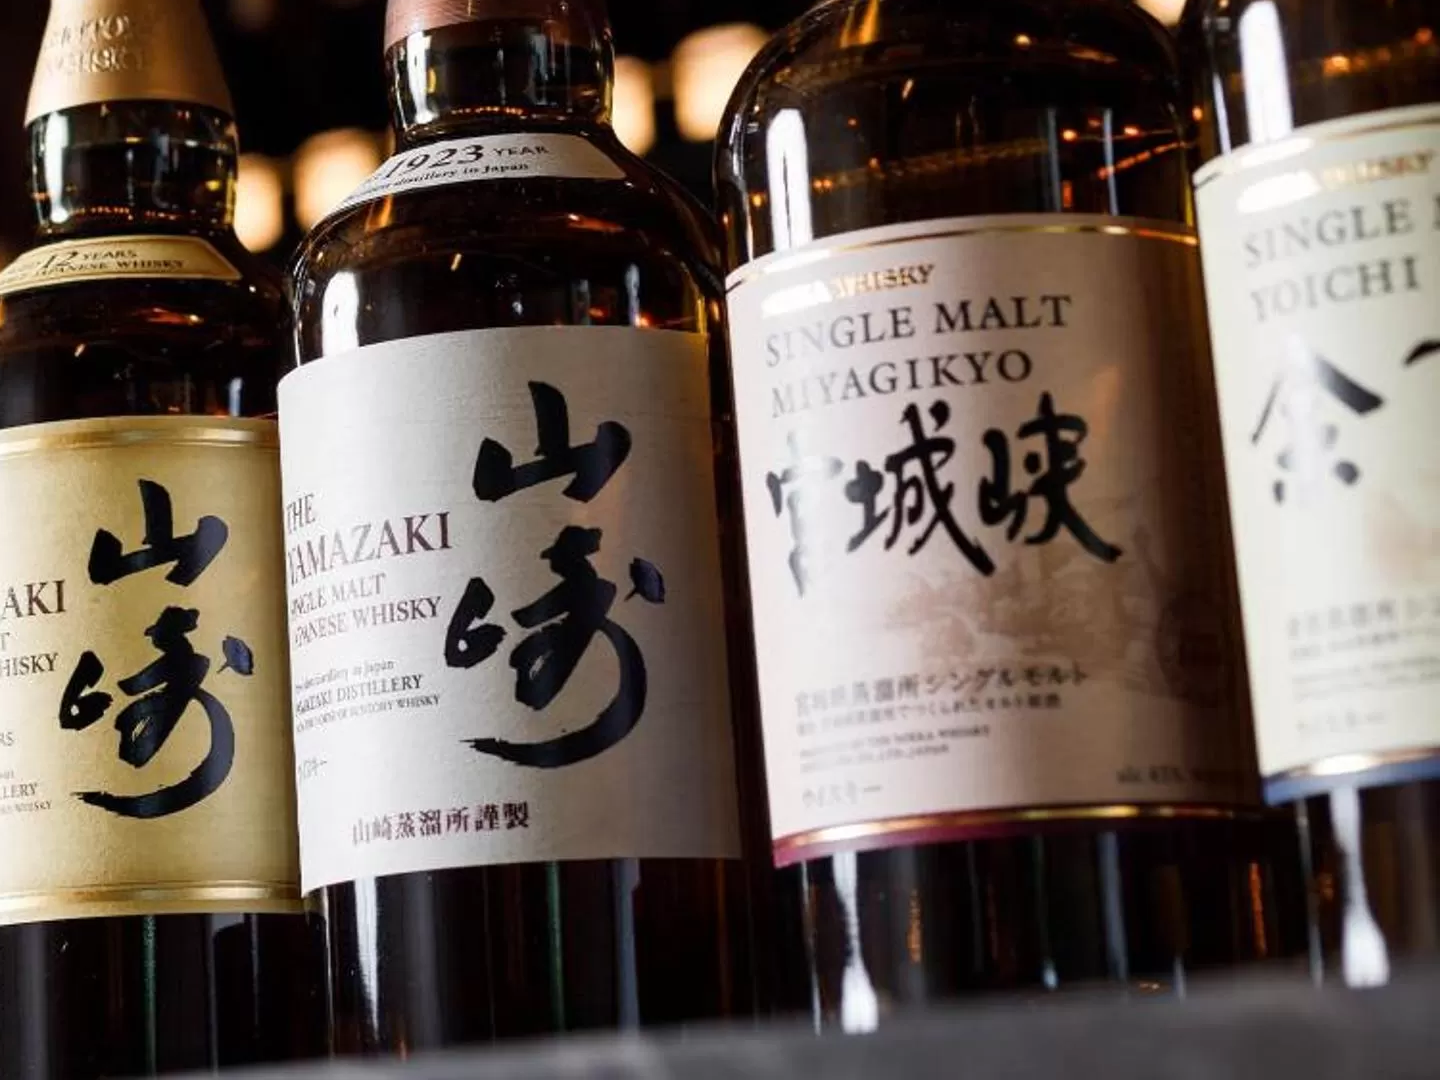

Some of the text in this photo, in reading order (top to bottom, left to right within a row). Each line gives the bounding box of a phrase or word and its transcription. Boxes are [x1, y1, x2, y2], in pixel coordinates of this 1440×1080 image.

[384, 143, 550, 179] 1923 YEAR
[463, 164, 480, 176] in
[482, 162, 529, 176] Japan
[1243, 198, 1417, 270] SINGLE
[83, 249, 140, 262] YEARS
[116, 259, 185, 272] WHISKY
[1250, 254, 1422, 324] YOICHI
[765, 293, 1073, 369] SINGLE MALT
[771, 348, 1034, 419] MIYAGIKYO
[287, 493, 316, 535] THE
[287, 511, 453, 586] YAMAZAKI
[332, 572, 386, 604] MALT
[352, 596, 442, 629] WHISKY
[336, 674, 423, 703] DISTILLERY
[351, 801, 530, 846] 山崎蒸溜所謹製
